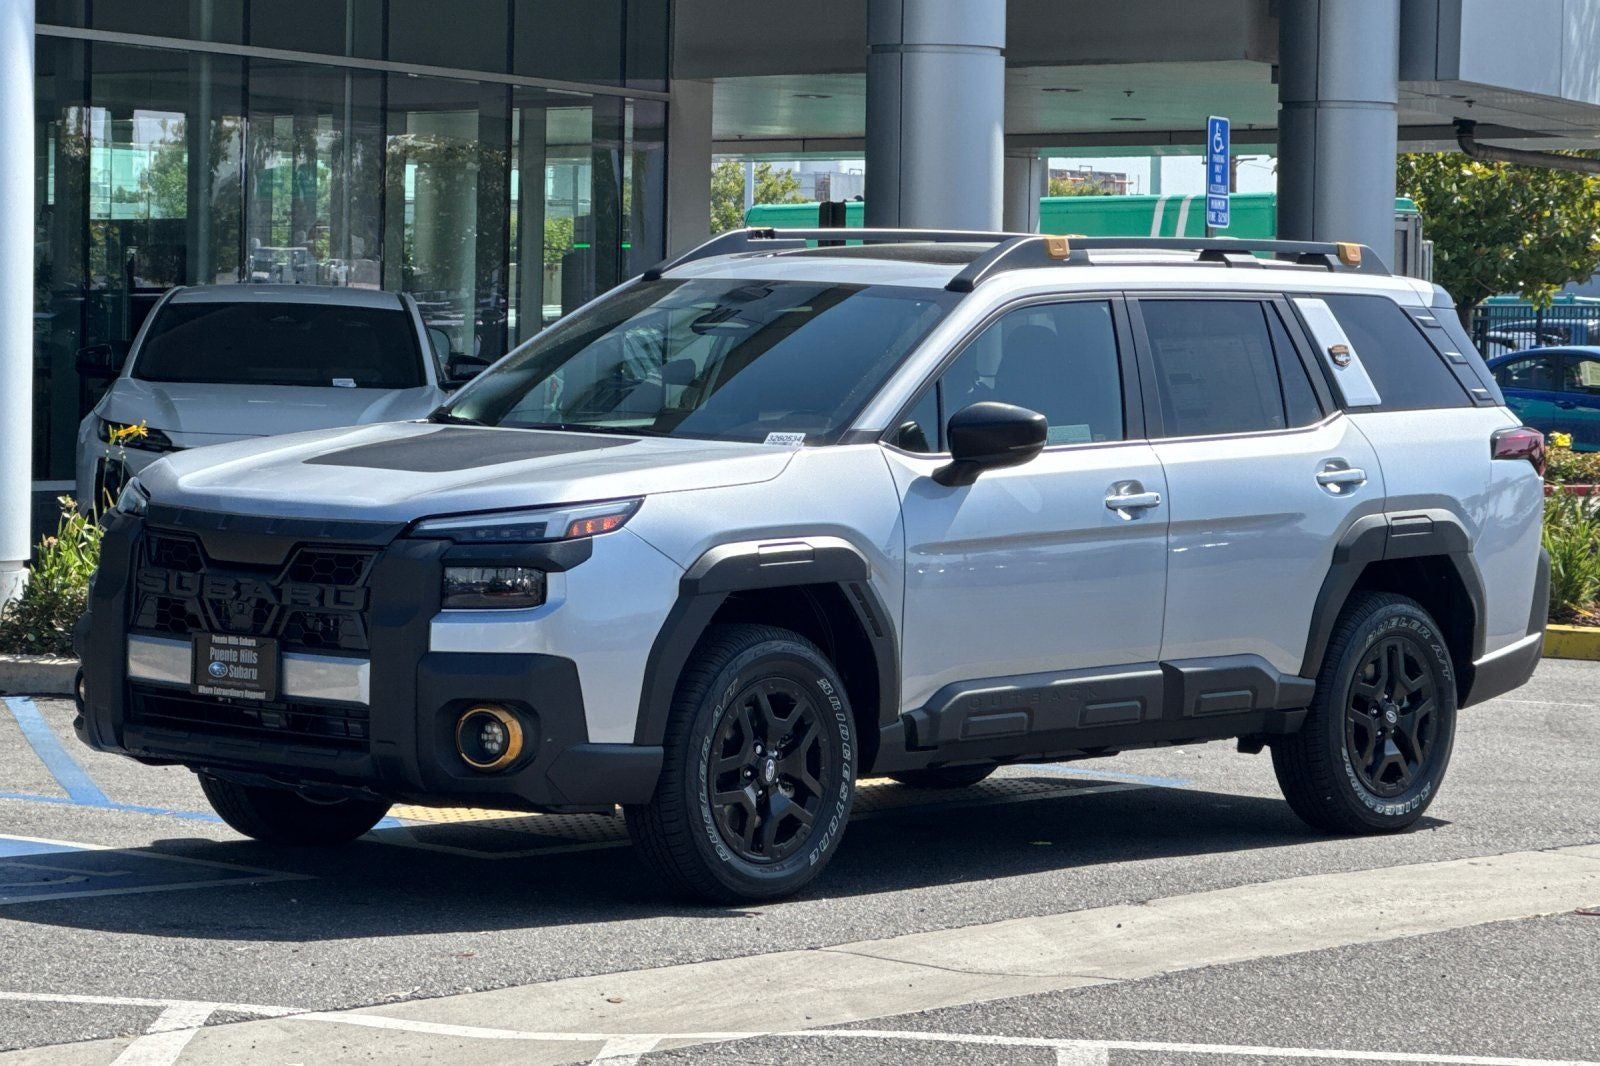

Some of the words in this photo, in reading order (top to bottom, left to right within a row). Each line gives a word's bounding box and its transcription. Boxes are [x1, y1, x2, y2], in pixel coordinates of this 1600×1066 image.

[136, 569, 368, 612] SUBARU
[1366, 617, 1432, 649] DUELER
[209, 647, 238, 662] Puente
[239, 649, 258, 664] Hills
[228, 664, 258, 680] Subaru
[969, 687, 1098, 710] OUTBACK
[811, 678, 851, 867] BRIDGESTONE
[699, 735, 731, 862] DUELER
